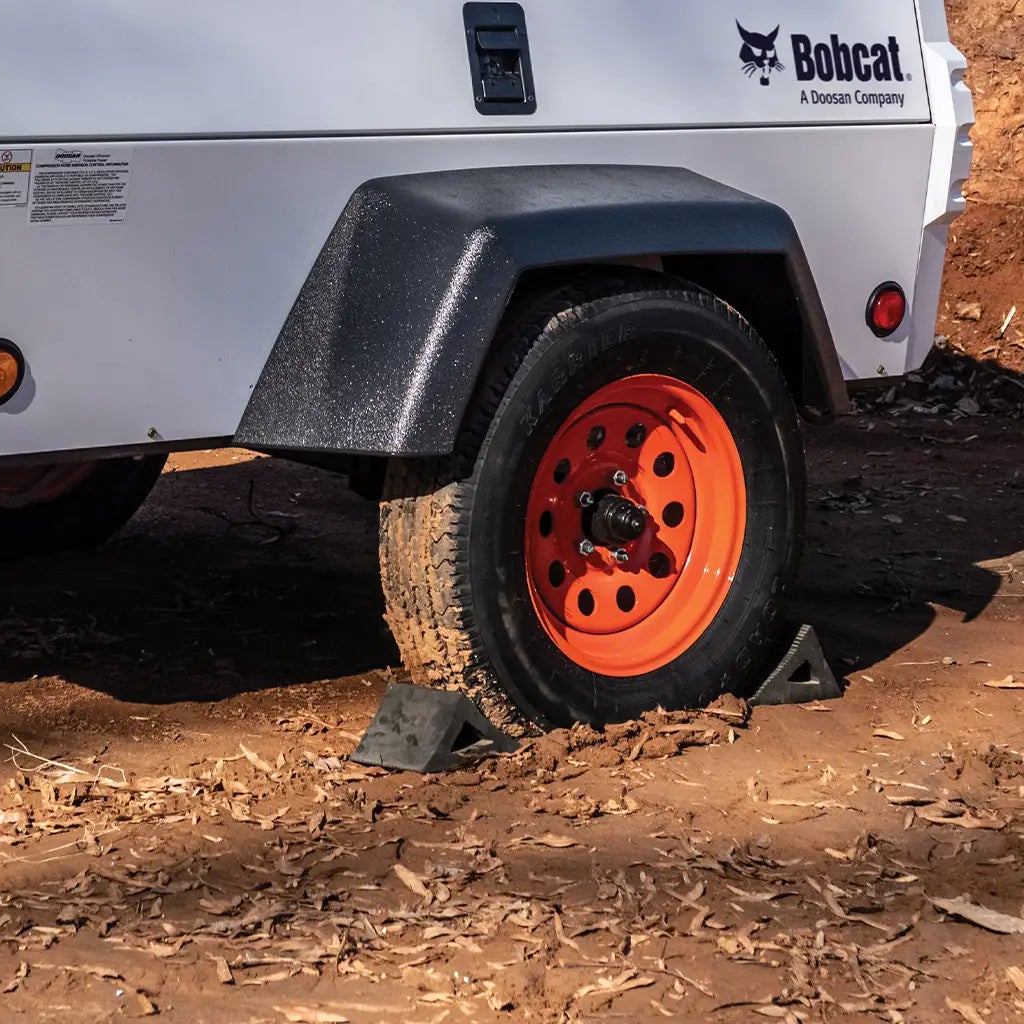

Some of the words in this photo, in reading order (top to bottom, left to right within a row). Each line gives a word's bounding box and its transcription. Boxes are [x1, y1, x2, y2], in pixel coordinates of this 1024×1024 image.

[790, 34, 904, 82] Bobcat
[800, 90, 809, 104] A
[811, 90, 851, 105] Doosan
[854, 90, 905, 108] Company
